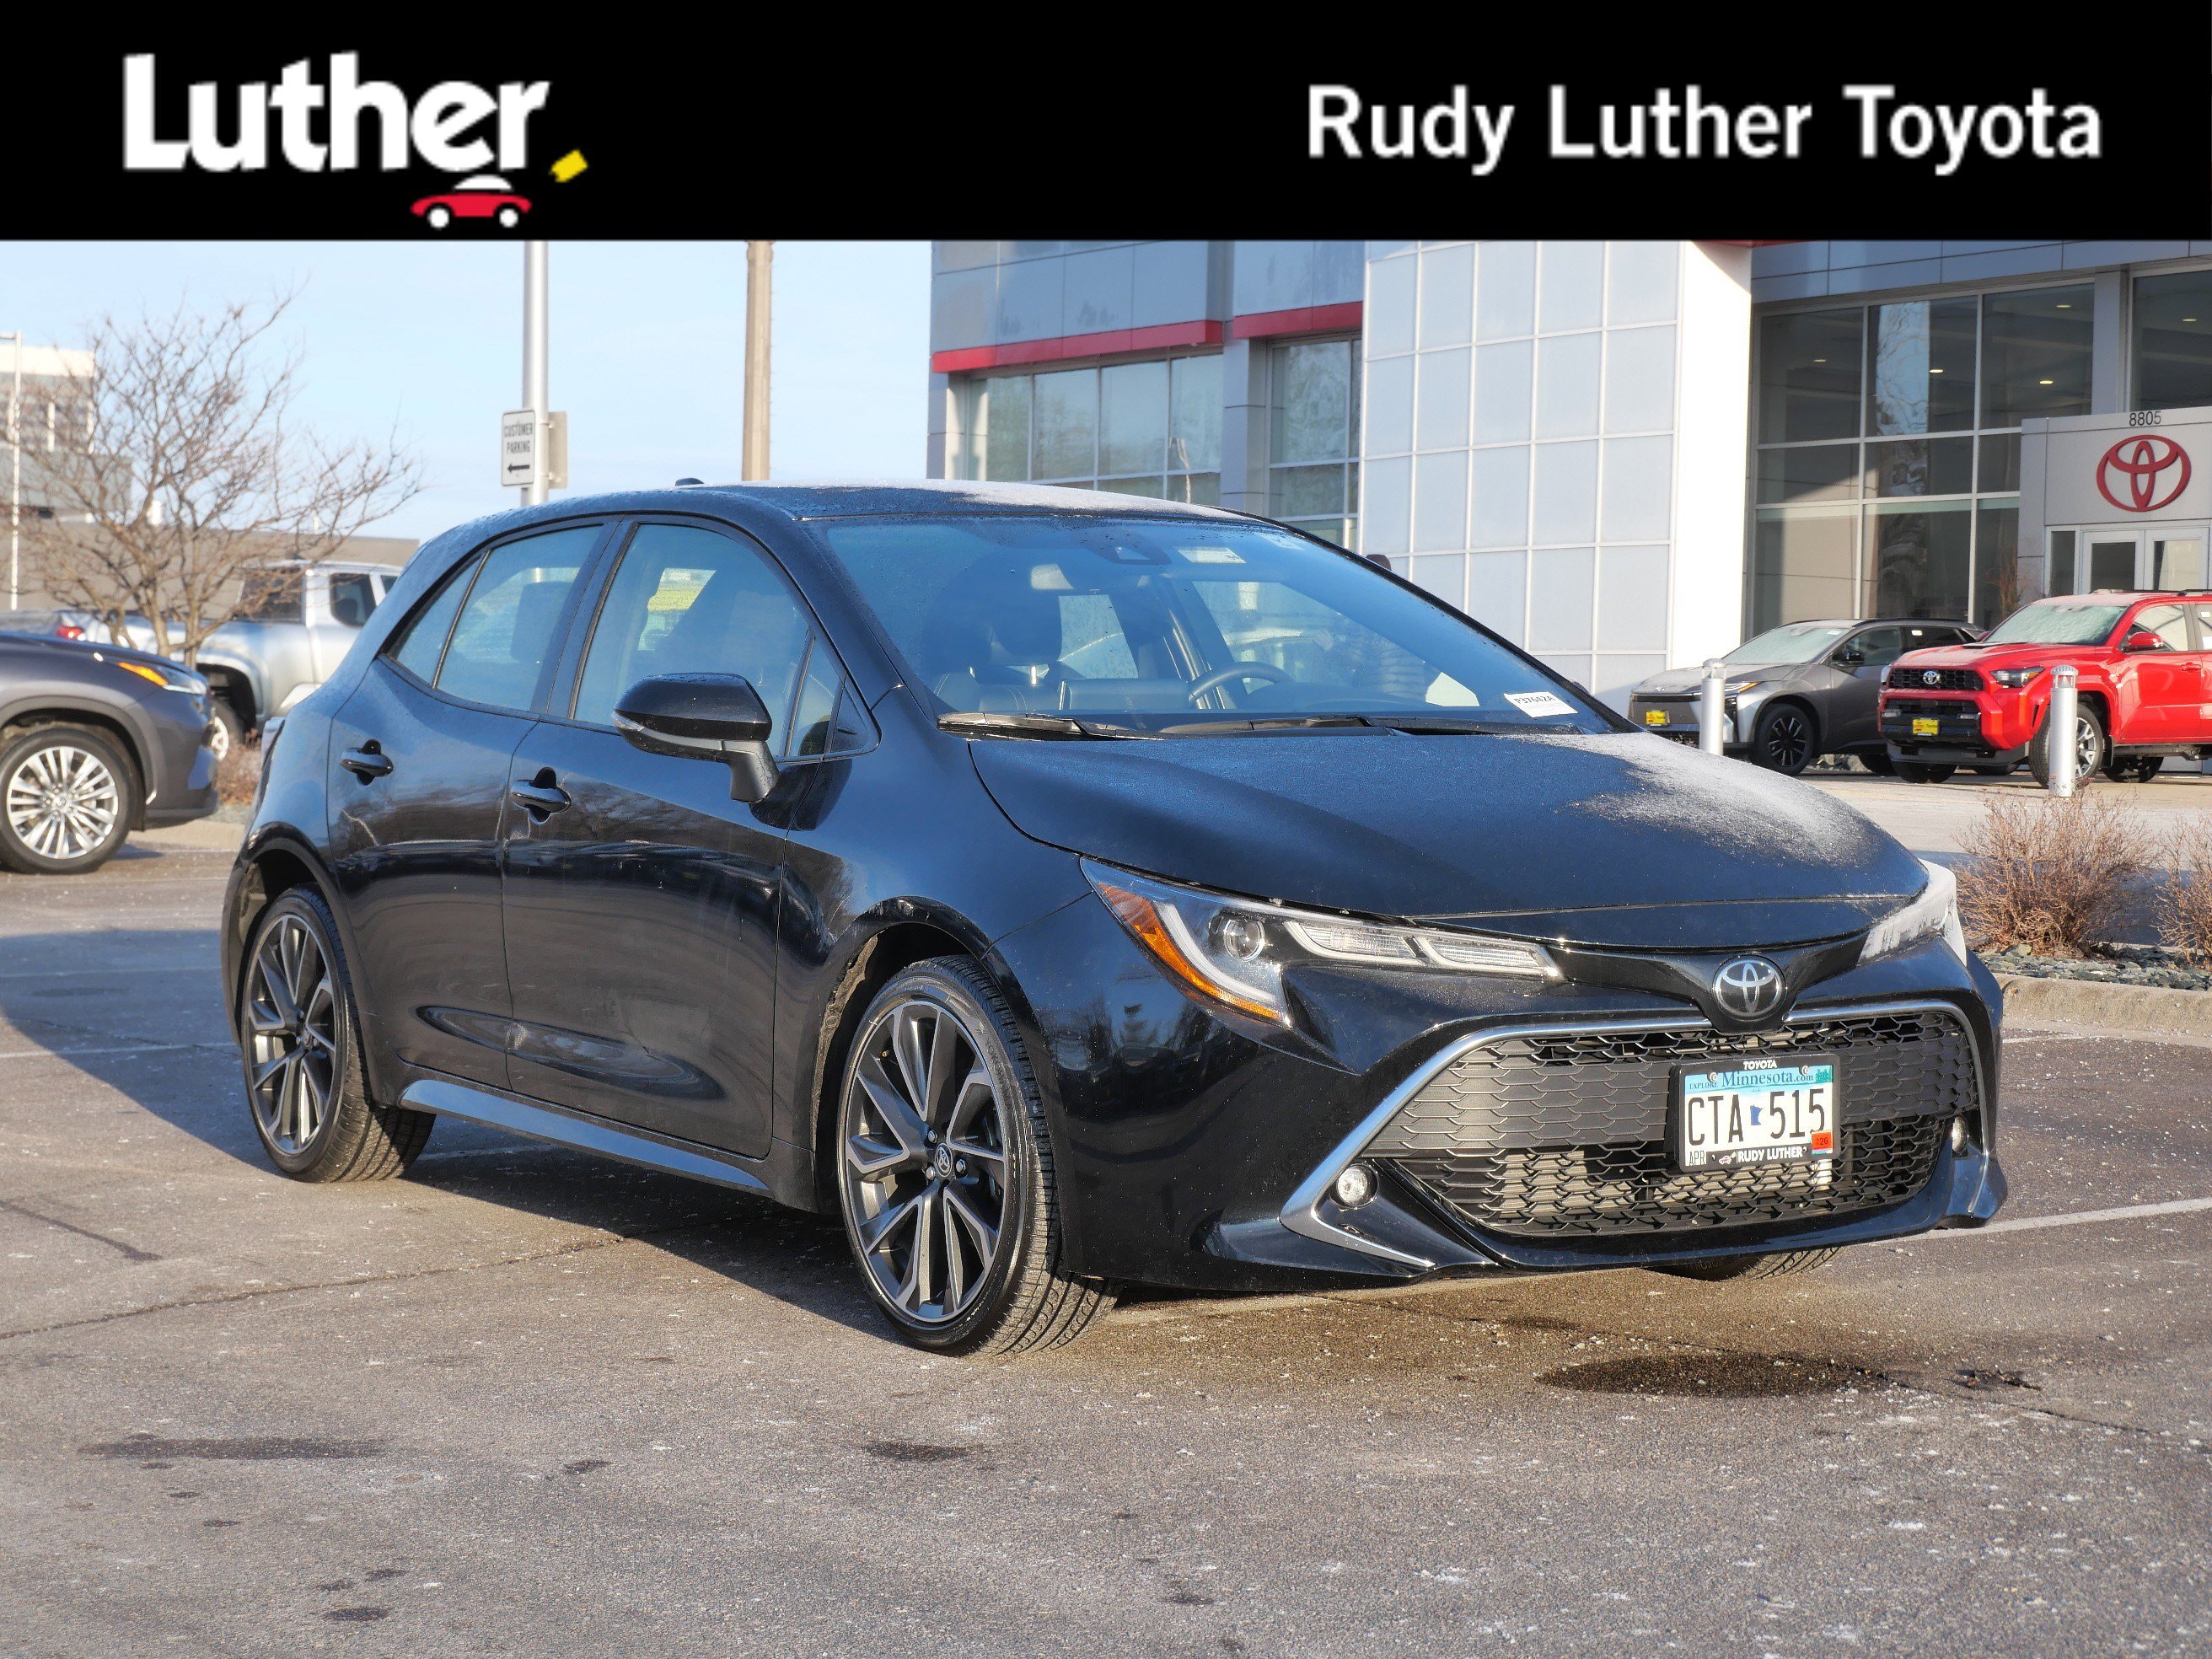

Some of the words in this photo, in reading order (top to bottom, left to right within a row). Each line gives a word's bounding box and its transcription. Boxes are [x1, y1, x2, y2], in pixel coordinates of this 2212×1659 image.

[2129, 411, 2161, 427] 8805
[505, 422, 533, 438] CUSTOMER
[507, 440, 530, 454] PARKING
[1743, 1060, 1777, 1071] TOYOTA
[1722, 1071, 1813, 1087] Minnesota.com
[1688, 1094, 1744, 1146] CTA
[1769, 1088, 1825, 1139] 515
[1819, 1136, 1828, 1146] 26
[1689, 1150, 1705, 1166] APR
[1737, 1149, 1764, 1163] RUDY
[1766, 1146, 1803, 1161] LUTHER
